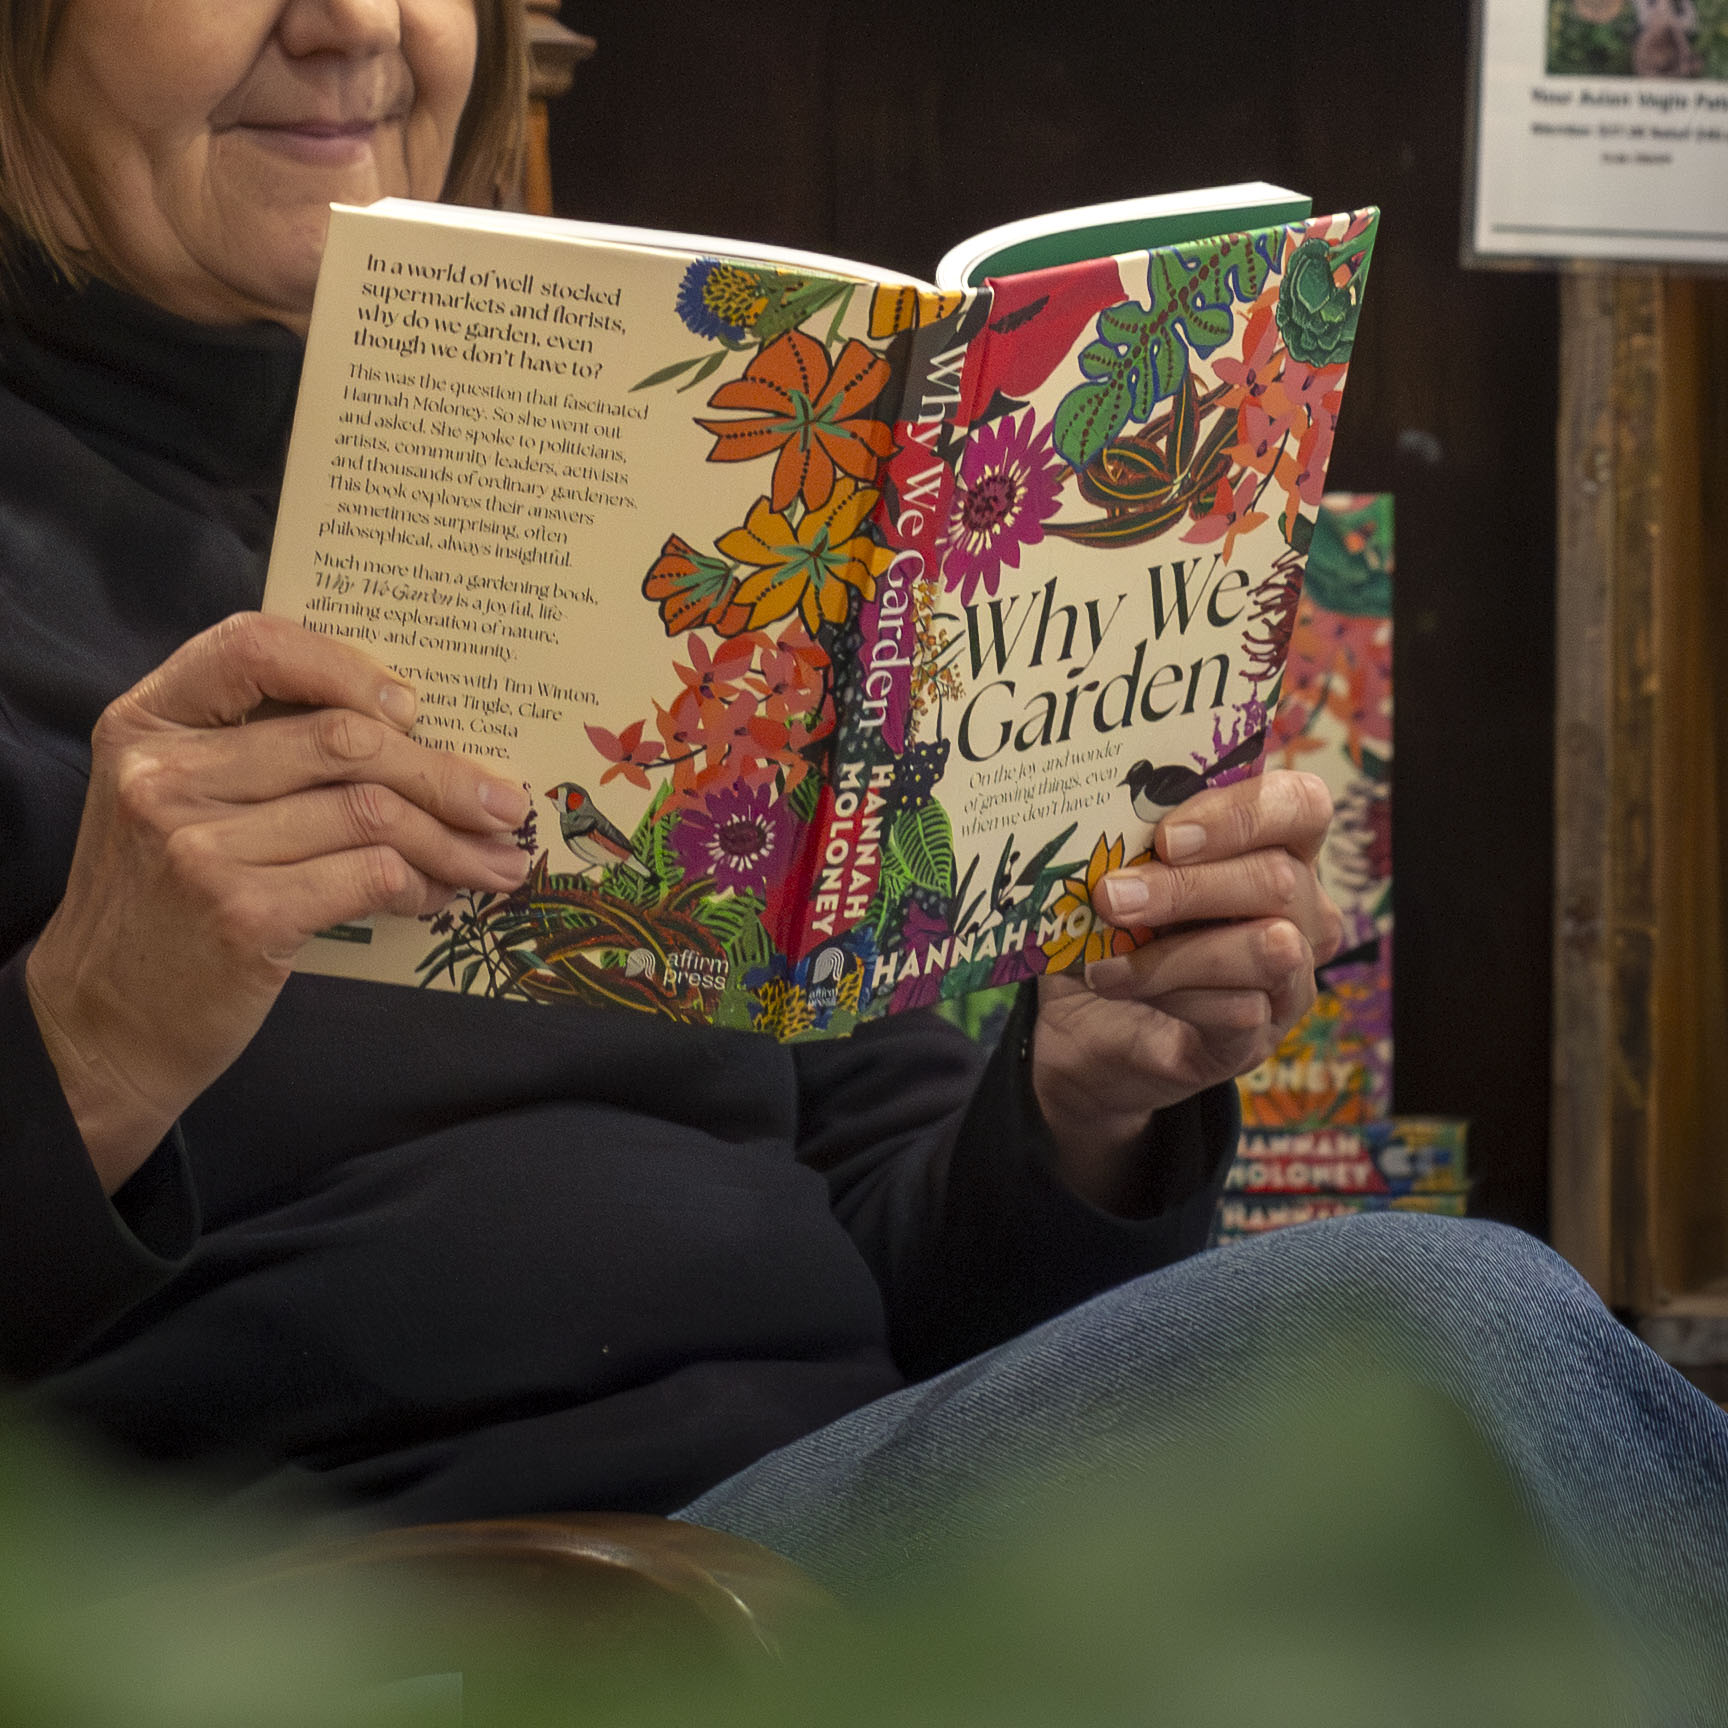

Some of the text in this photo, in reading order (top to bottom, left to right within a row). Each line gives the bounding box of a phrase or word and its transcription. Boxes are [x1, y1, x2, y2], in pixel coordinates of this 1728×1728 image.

[368, 254, 622, 306] In world of well stocked
[358, 305, 593, 353] why do we garden, even
[361, 281, 626, 335] supermarkets and florists,
[353, 328, 603, 379] though we don't have to?
[344, 385, 623, 439] Hannah Moloney. So she went out
[350, 363, 649, 420] This was the question that fascinated
[334, 432, 629, 485] artists, community leaders, activists
[339, 410, 627, 464] and asked. She spoke to politicians,
[328, 474, 595, 525] This book explores their answers
[331, 453, 637, 510] and thousands ordinary gardeners.
[318, 520, 572, 568] philosophical, always insightful.
[337, 501, 568, 544] sometimes surprising, often
[858, 342, 968, 732] Why We Garden
[313, 550, 599, 606] Much more than gardening book,
[392, 583, 454, 606] Garden
[302, 615, 518, 662] humanity and community.
[305, 595, 559, 645] affirming exploration nature,
[965, 553, 1250, 680] Why We
[464, 672, 600, 706] with Winton,
[518, 702, 563, 722] Clare
[958, 638, 1230, 762] Garden
[469, 717, 519, 739] Costa
[969, 740, 1124, 789] On and wonder
[961, 793, 1094, 837] when don't have
[980, 766, 1118, 815] growing even
[812, 761, 865, 936] MOLONEY
[843, 764, 894, 919] HANNAH
[662, 967, 727, 990] press
[666, 949, 729, 973] affirm
[872, 920, 1028, 988] HANNAH
